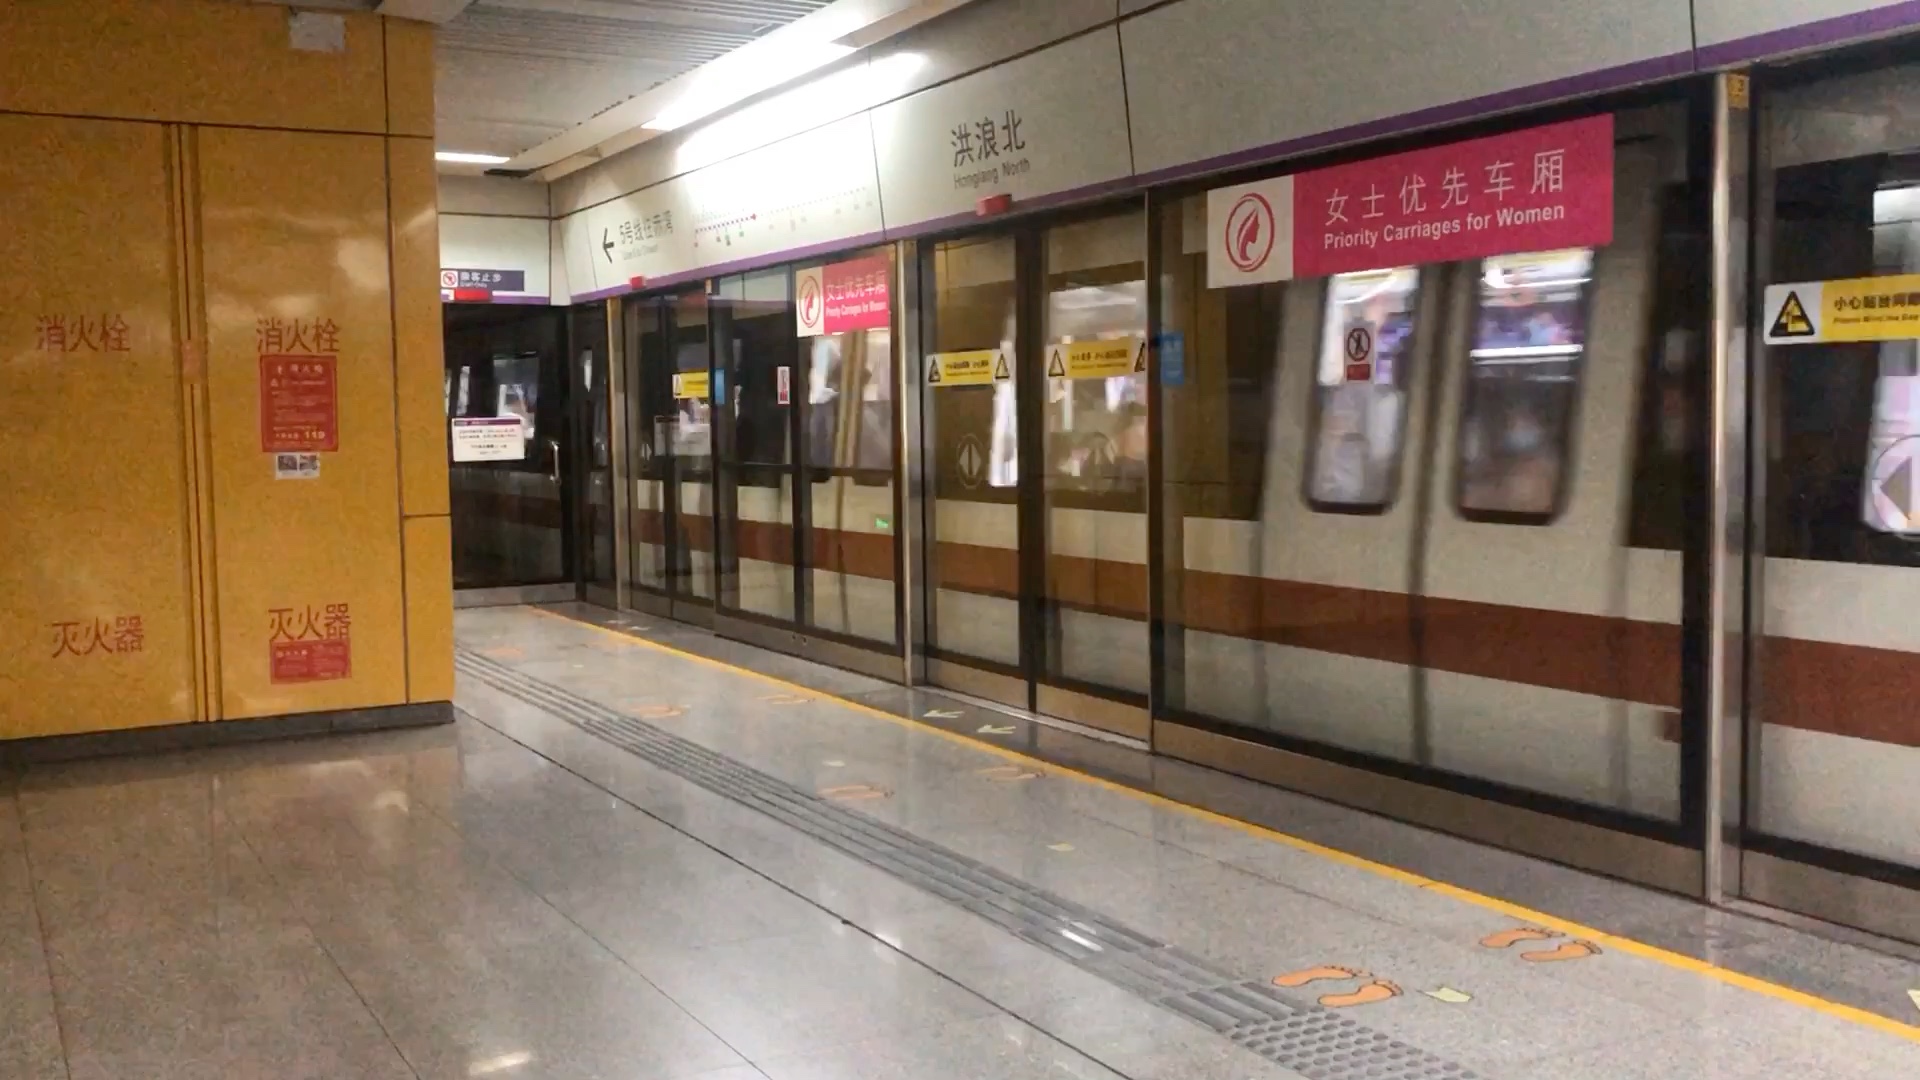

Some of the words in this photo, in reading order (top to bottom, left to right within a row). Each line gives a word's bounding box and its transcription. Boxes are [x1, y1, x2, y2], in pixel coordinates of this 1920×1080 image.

[951, 109, 1026, 168] 洪浪北
[1325, 149, 1565, 227] 女士优先车厢
[1324, 228, 1378, 249] Priority
[1383, 219, 1461, 242] Carriages
[1467, 212, 1492, 231] for
[1497, 204, 1565, 227] Women
[36, 313, 131, 353] 消火栓
[256, 316, 341, 354] 消火栓
[51, 614, 144, 659] 灭火器
[267, 603, 351, 642] 灭火器
